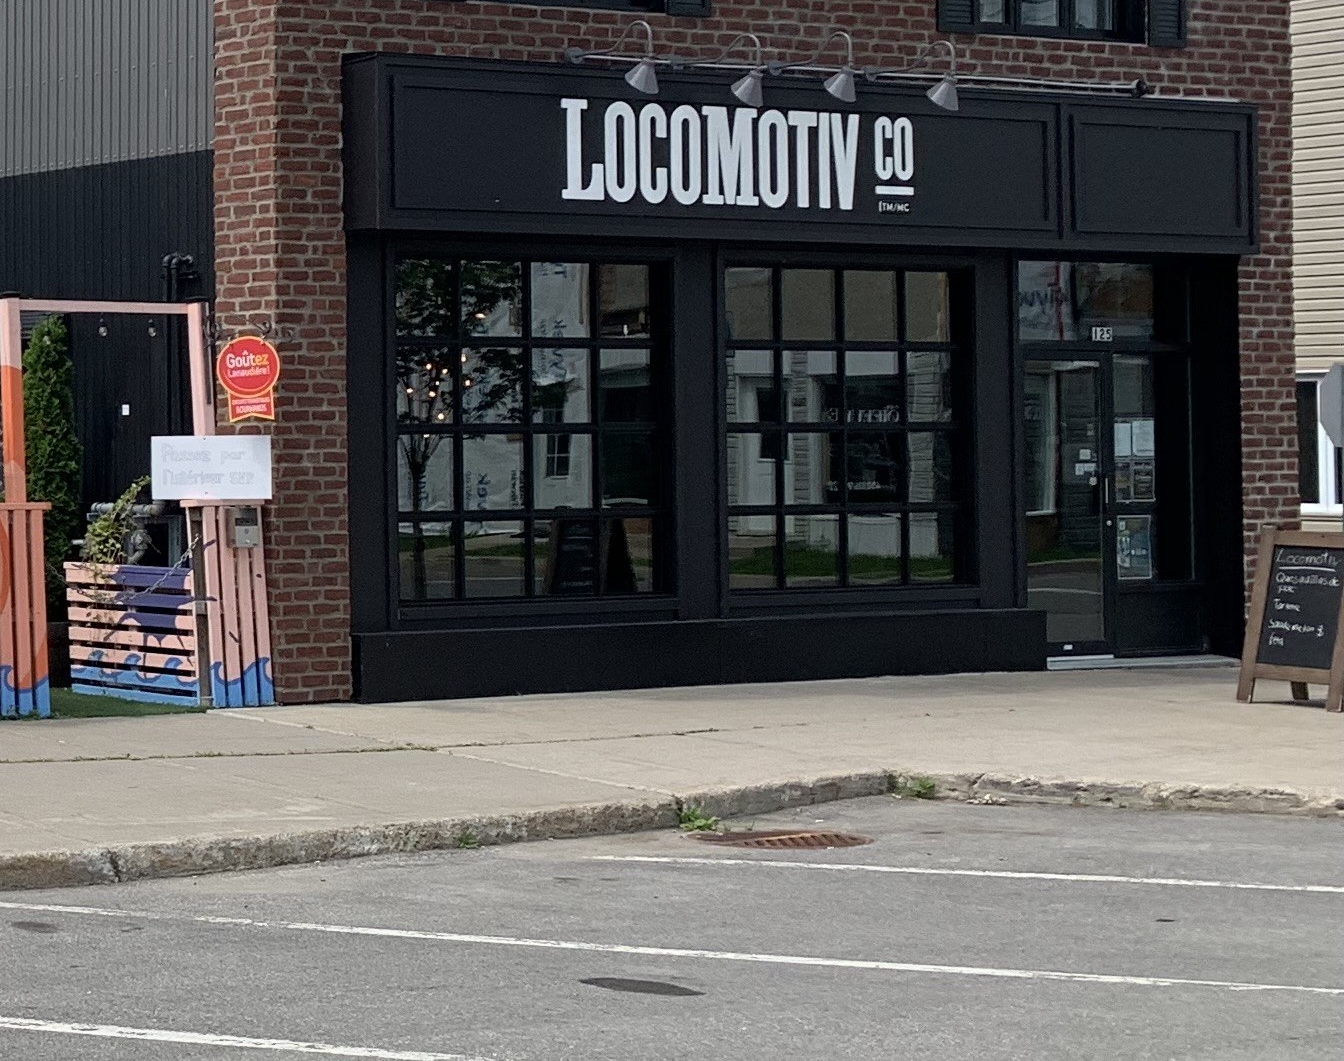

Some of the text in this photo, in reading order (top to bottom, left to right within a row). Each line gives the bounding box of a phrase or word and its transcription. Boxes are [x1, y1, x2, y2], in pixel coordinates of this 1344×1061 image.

[561, 98, 914, 210] LOCOMOTIV CO
[1094, 327, 1112, 340] 125
[226, 350, 270, 369] Goûtez
